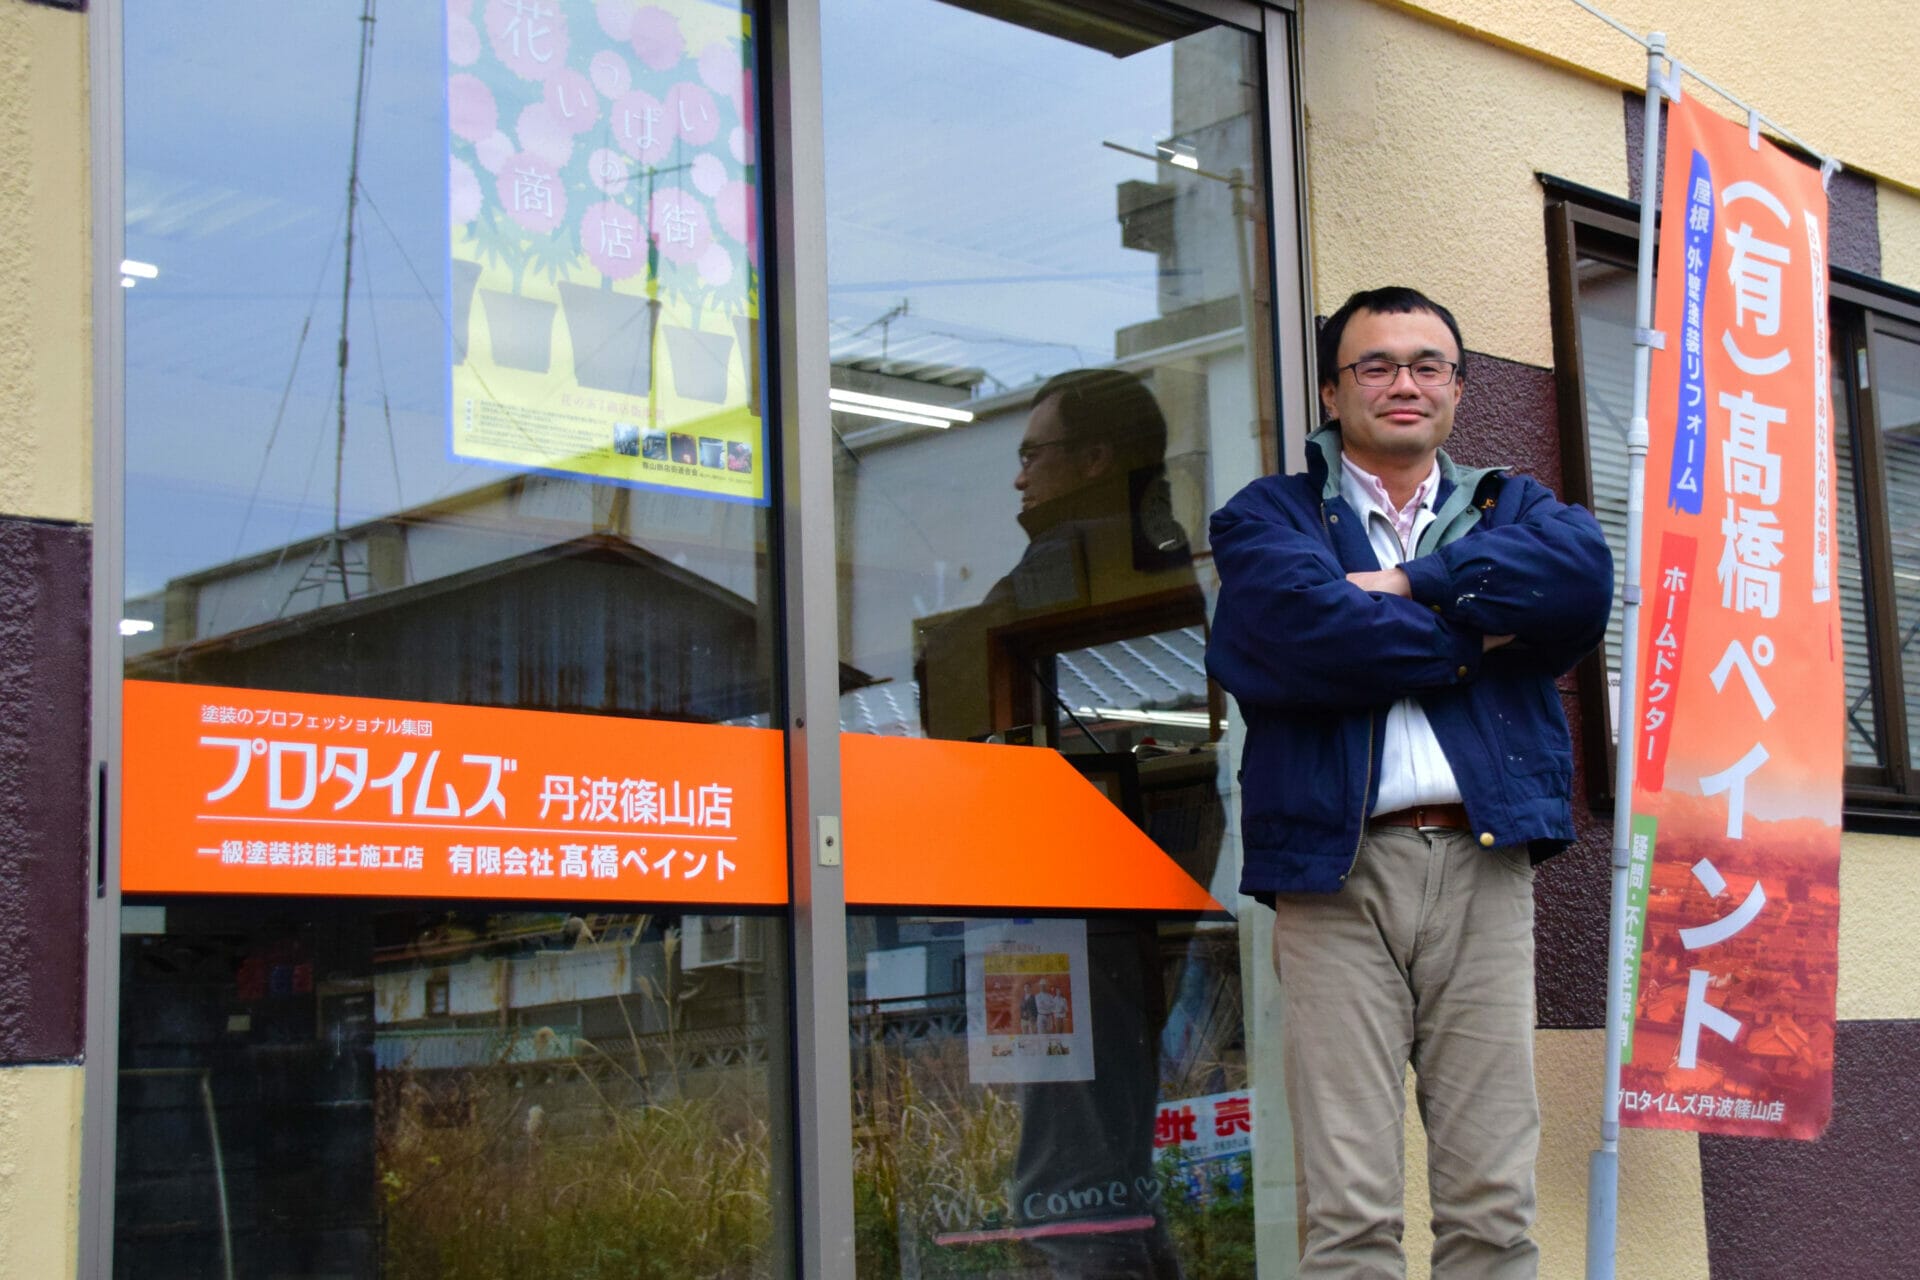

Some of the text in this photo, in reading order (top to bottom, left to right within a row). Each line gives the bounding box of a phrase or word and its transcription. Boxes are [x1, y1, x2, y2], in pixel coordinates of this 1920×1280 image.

[1676, 175, 1713, 494] 屋根・外壁塗装リフォーム
[1644, 566, 1687, 761] ホームドクター
[201, 704, 433, 736] 塗装のプロフェッショナル集団
[200, 736, 734, 829] プロタイムズ 丹波篠山店
[197, 840, 425, 869] 一級塗装技能士施工店
